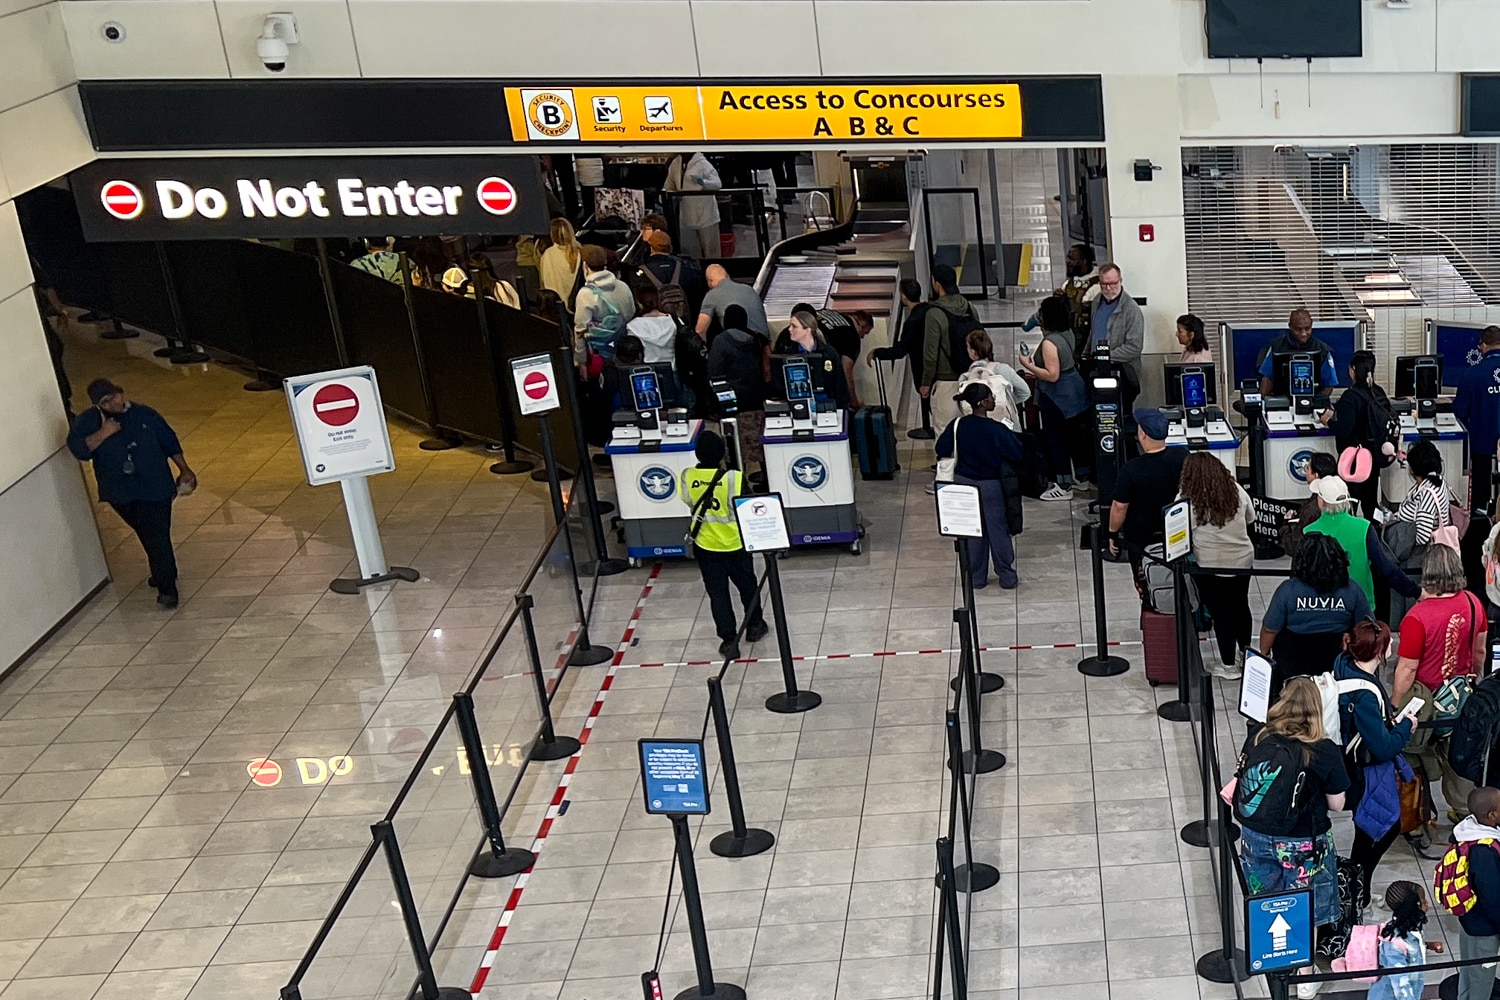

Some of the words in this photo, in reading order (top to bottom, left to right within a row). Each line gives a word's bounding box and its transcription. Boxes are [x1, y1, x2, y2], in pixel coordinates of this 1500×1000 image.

[532, 94, 565, 106] SECURITY
[719, 90, 807, 110] Access
[817, 90, 845, 109] to
[854, 89, 1005, 109] Concourses
[542, 105, 561, 125] B
[532, 120, 571, 135] CHECKPOINT
[594, 125, 626, 133] Security
[813, 117, 833, 136] A
[850, 117, 866, 136] B
[875, 117, 894, 135] &
[903, 116, 919, 135] C
[155, 180, 228, 219] Do
[236, 178, 330, 218] Not
[337, 178, 463, 217] Enter
[1253, 498, 1287, 514] Please
[1254, 511, 1277, 525] Wait
[1254, 522, 1278, 537] Here
[1296, 597, 1346, 609] NUVIA
